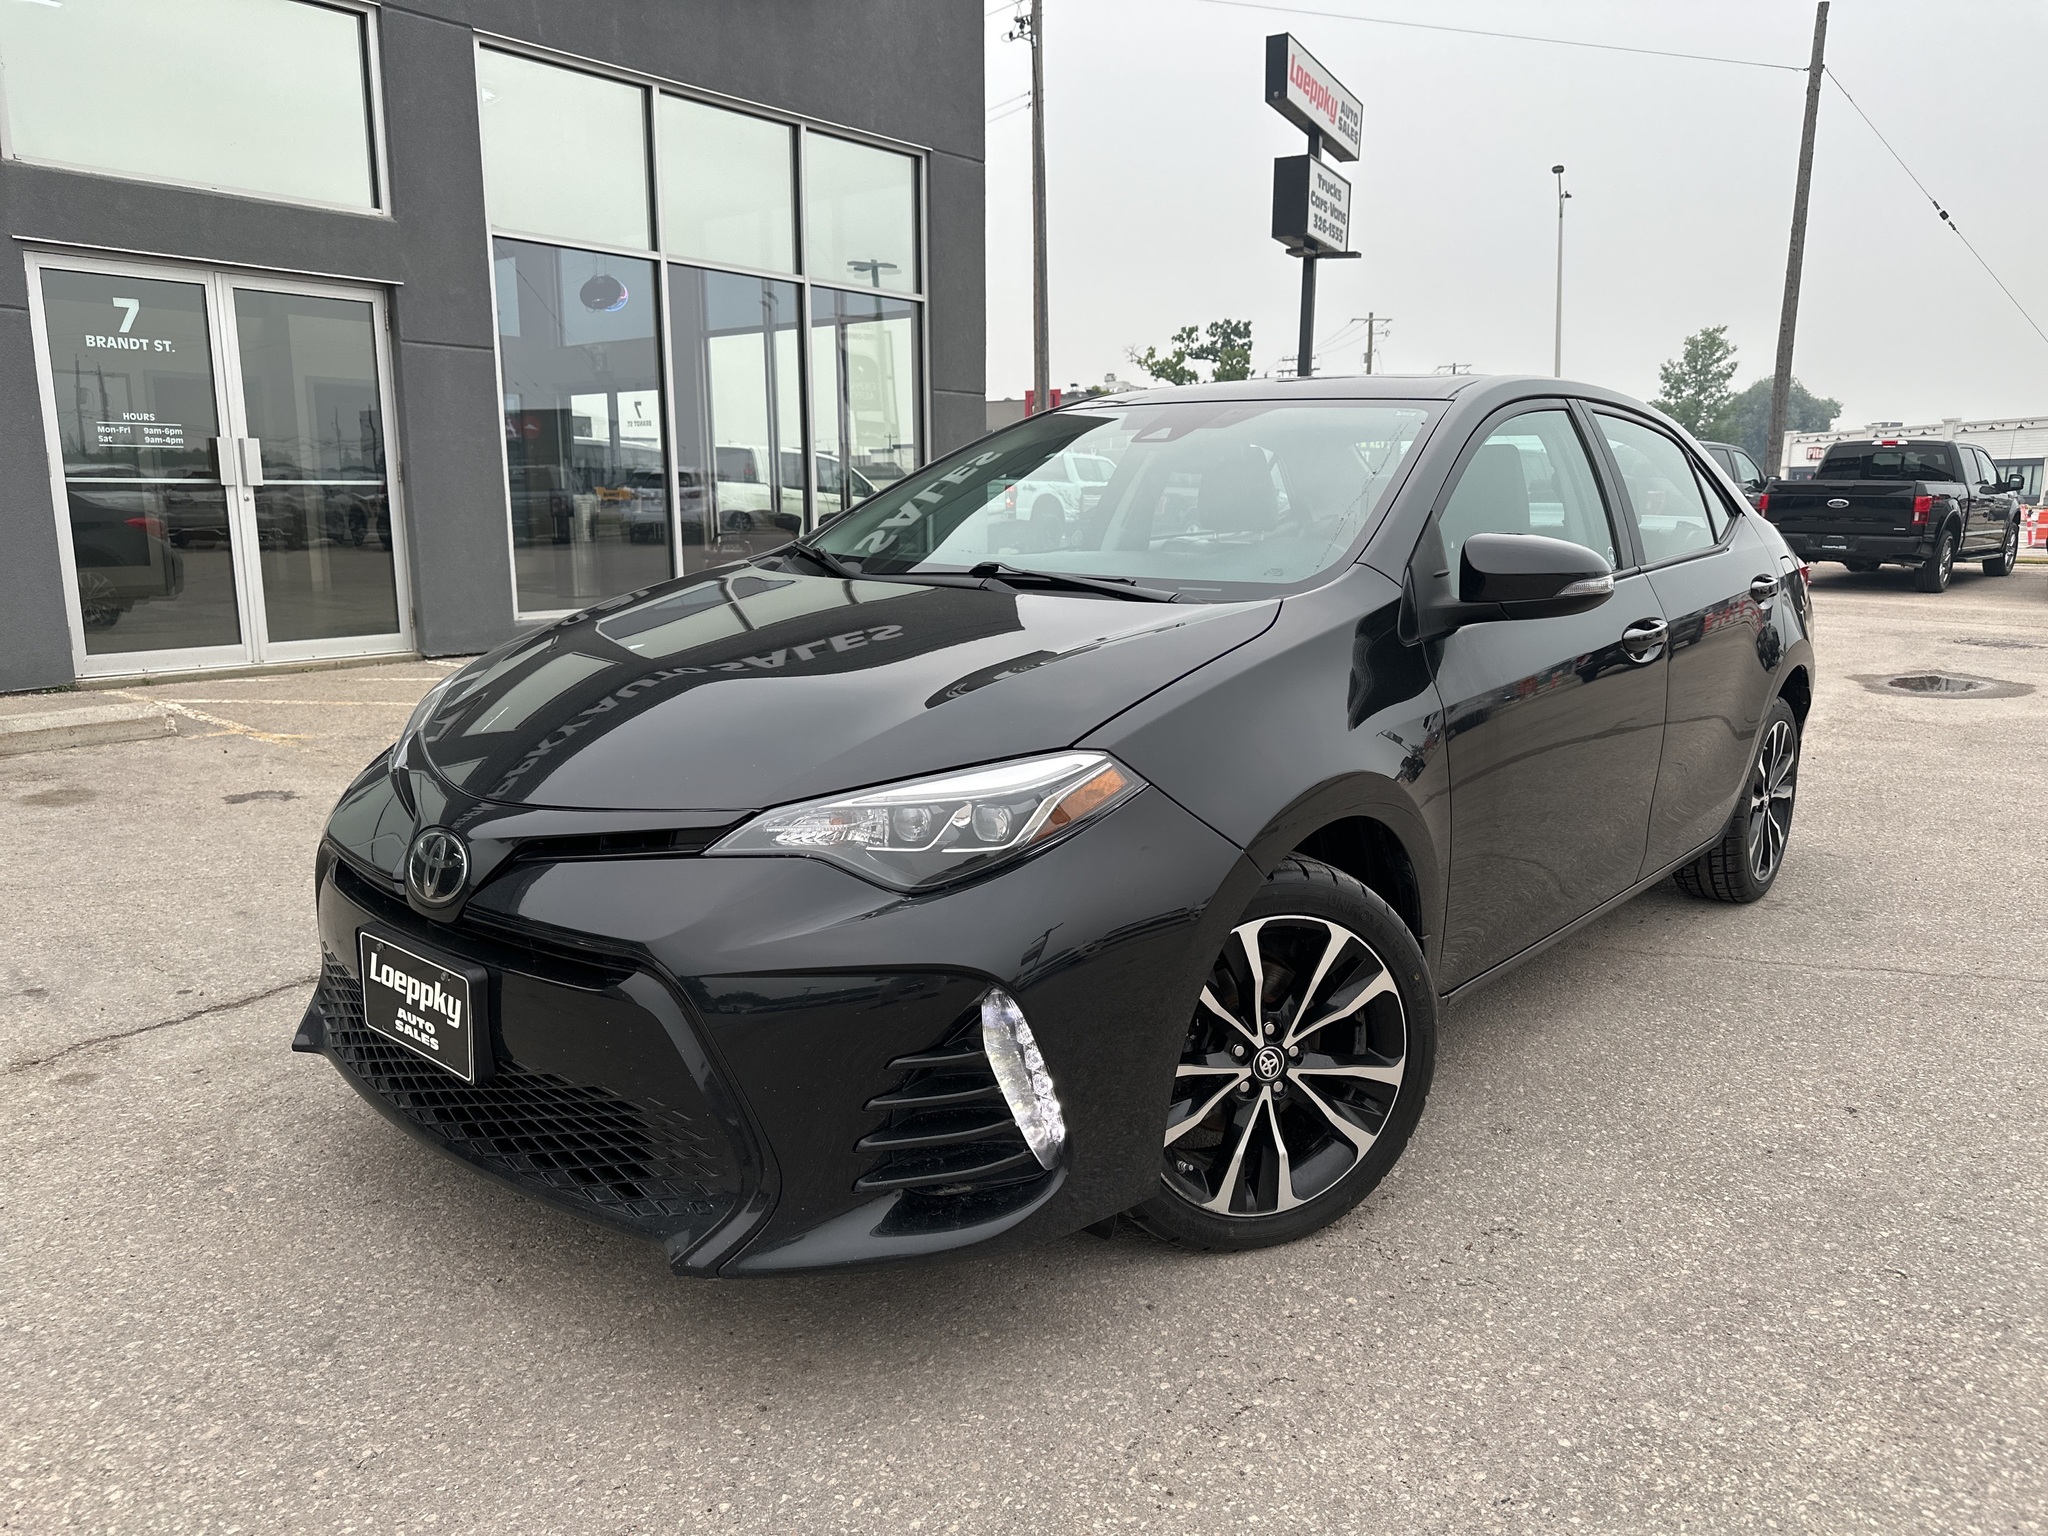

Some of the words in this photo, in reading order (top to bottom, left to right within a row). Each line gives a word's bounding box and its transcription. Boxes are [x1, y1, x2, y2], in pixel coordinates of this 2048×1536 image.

[1289, 53, 1338, 125] Loeppky
[1340, 100, 1359, 128] AUTO
[1337, 117, 1359, 146] SALES
[1317, 172, 1342, 202] Trucks
[1313, 213, 1344, 244] 326-1555
[112, 297, 140, 333] 7
[85, 334, 149, 351] BRANDT
[154, 340, 176, 353] ST.
[97, 425, 131, 434] Mon-Fri
[143, 427, 183, 436] 9am-6pm
[123, 412, 156, 421] HOURS
[98, 435, 113, 443] Sat
[144, 436, 184, 445] 9am-4pm
[369, 951, 462, 1029] Loeppky
[394, 1019, 440, 1051] SALES
[397, 1007, 436, 1035] AUTO
